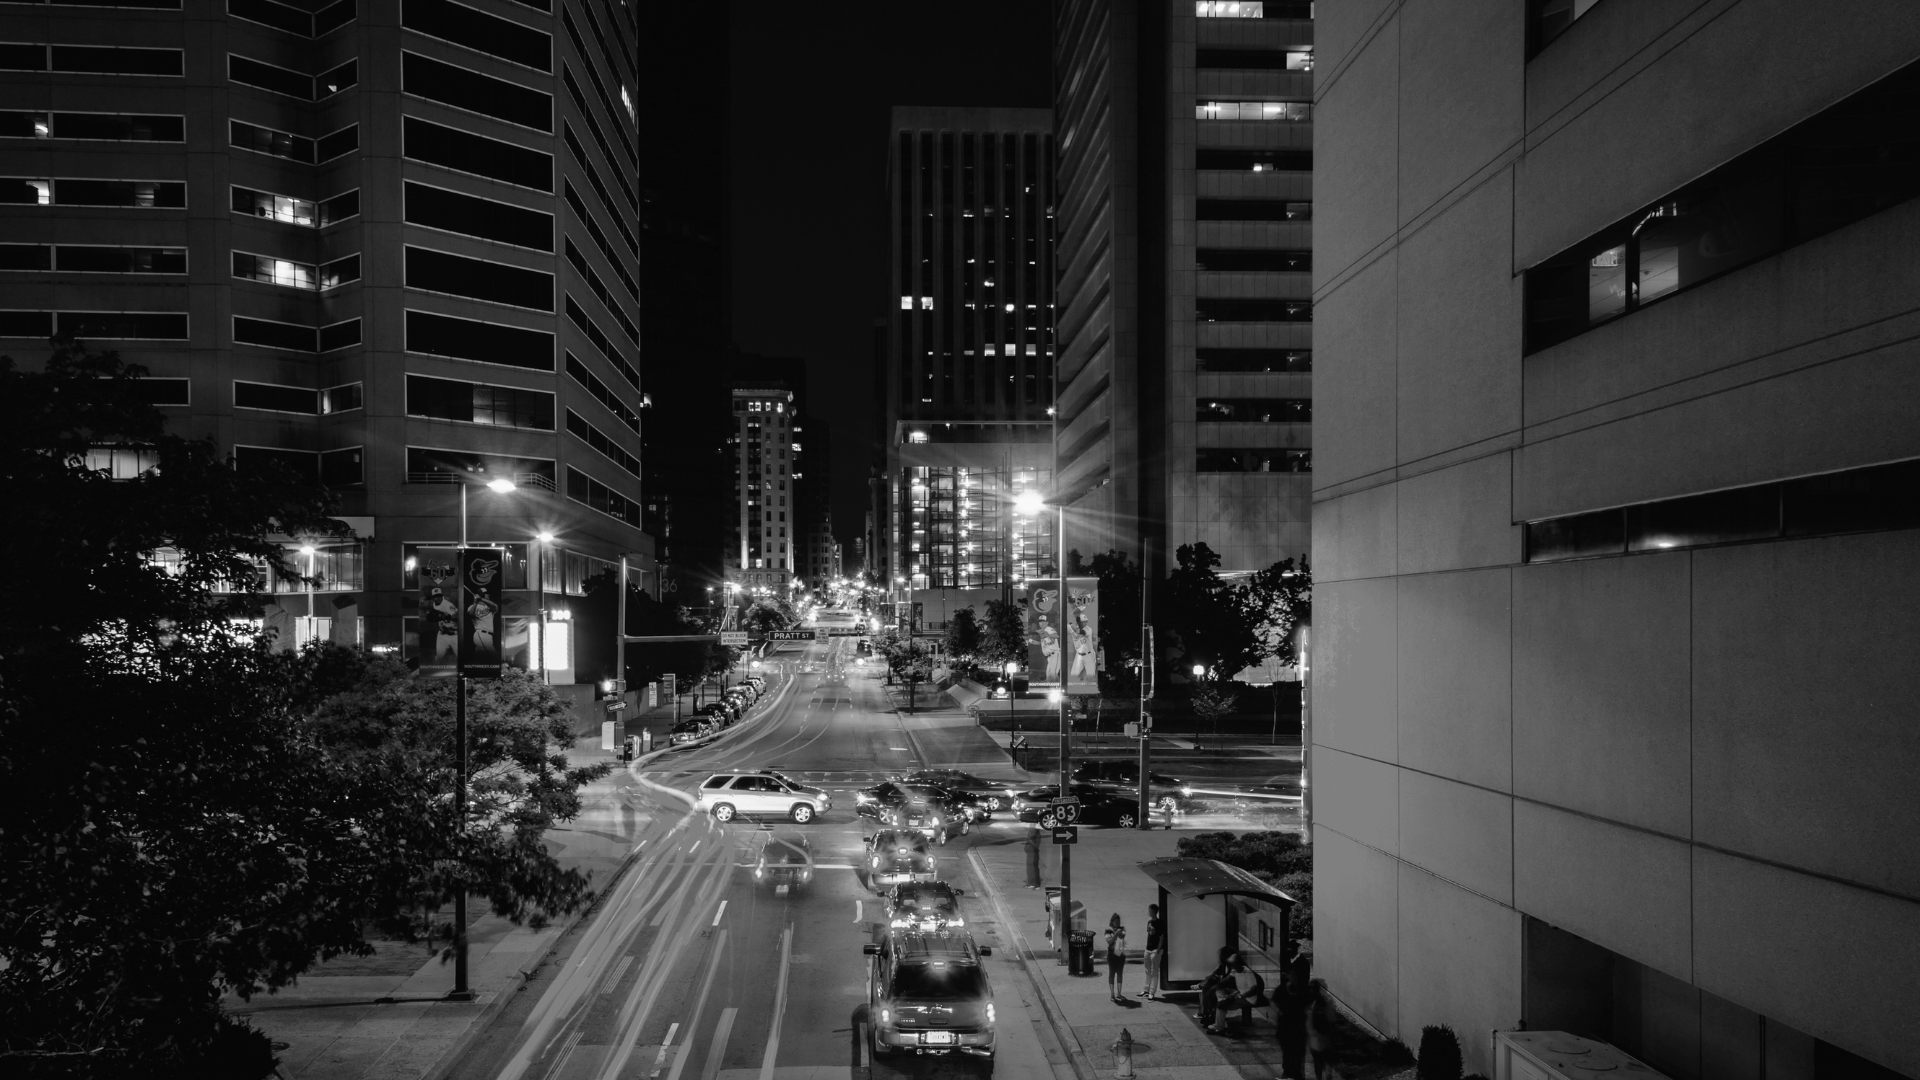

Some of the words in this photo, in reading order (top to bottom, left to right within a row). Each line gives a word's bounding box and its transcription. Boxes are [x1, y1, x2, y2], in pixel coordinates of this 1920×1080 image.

[430, 568, 446, 578] 60
[774, 632, 800, 640] PRATT
[1056, 801, 1076, 819] 83
